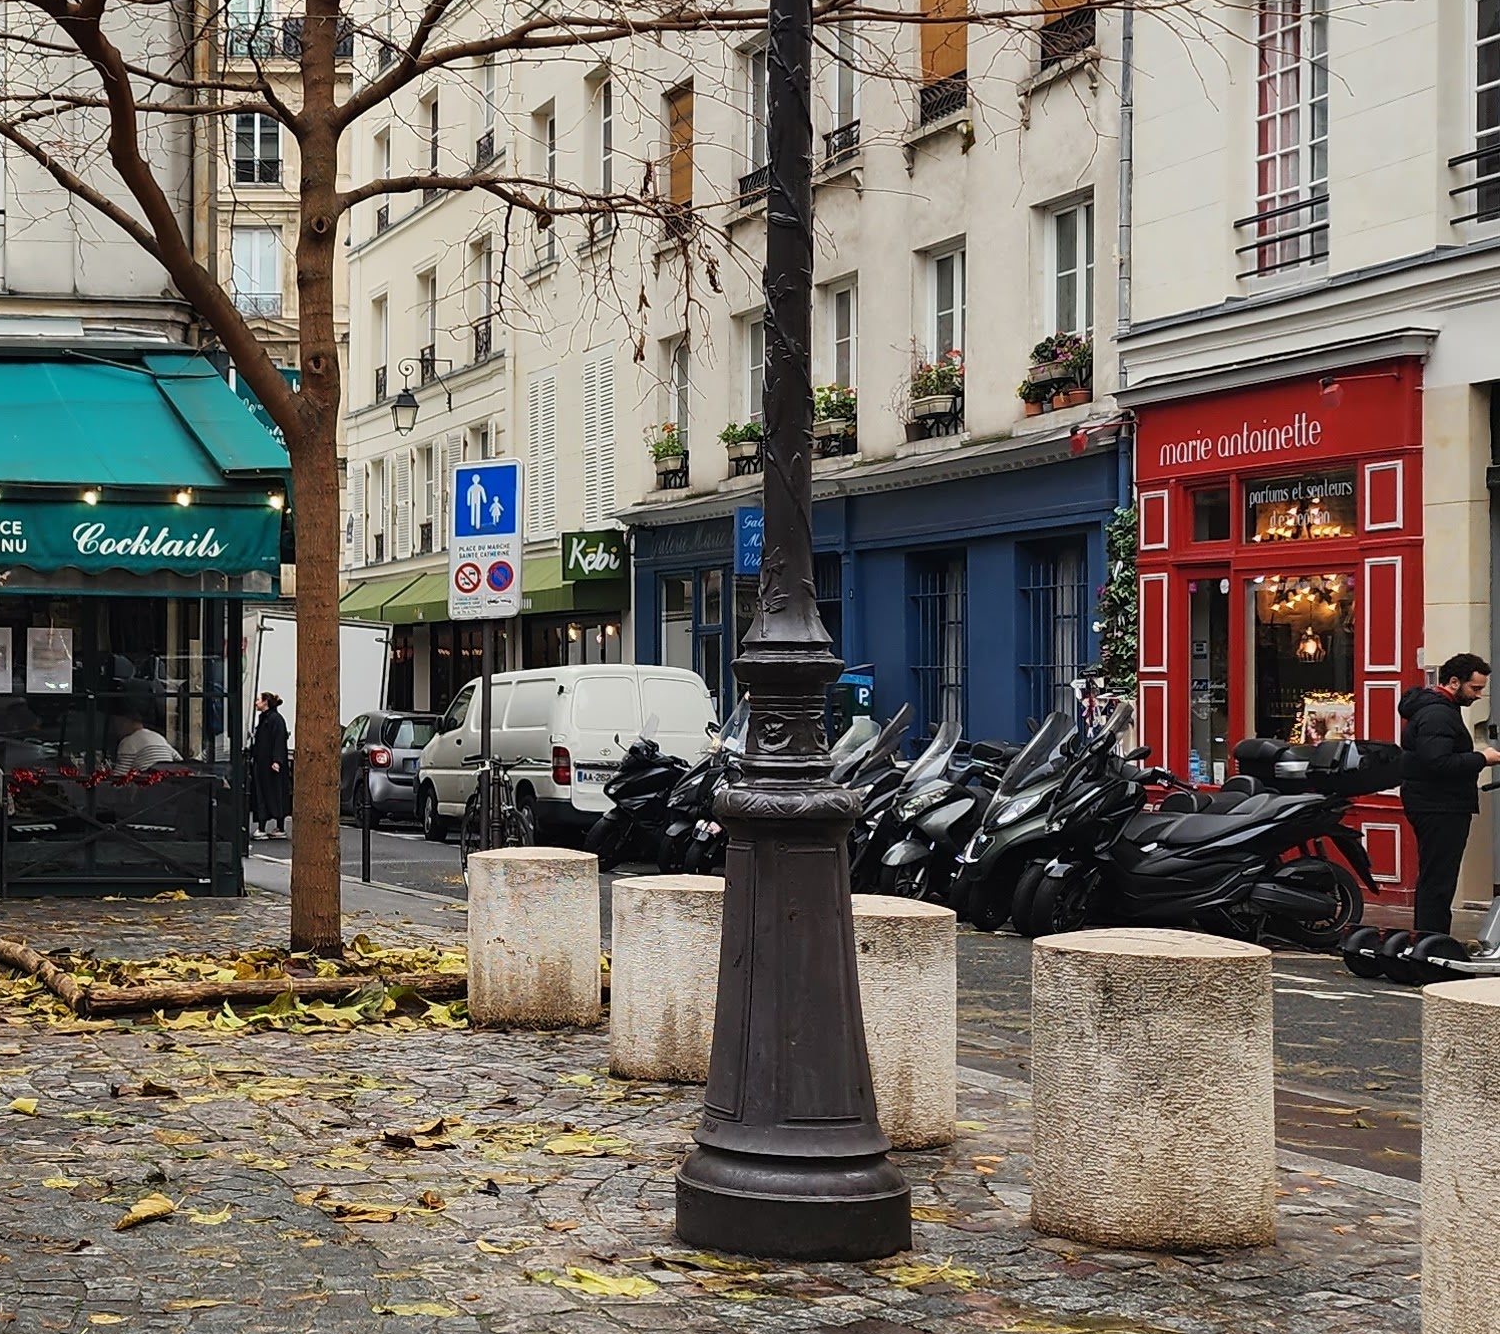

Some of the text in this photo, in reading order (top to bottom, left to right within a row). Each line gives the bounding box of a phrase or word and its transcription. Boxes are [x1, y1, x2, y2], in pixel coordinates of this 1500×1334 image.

[1159, 412, 1322, 467] marie antoinette
[1248, 478, 1354, 508] parfums et senteurs
[72, 522, 229, 558] Cocktails
[480, 550, 510, 558] CATHERINE
